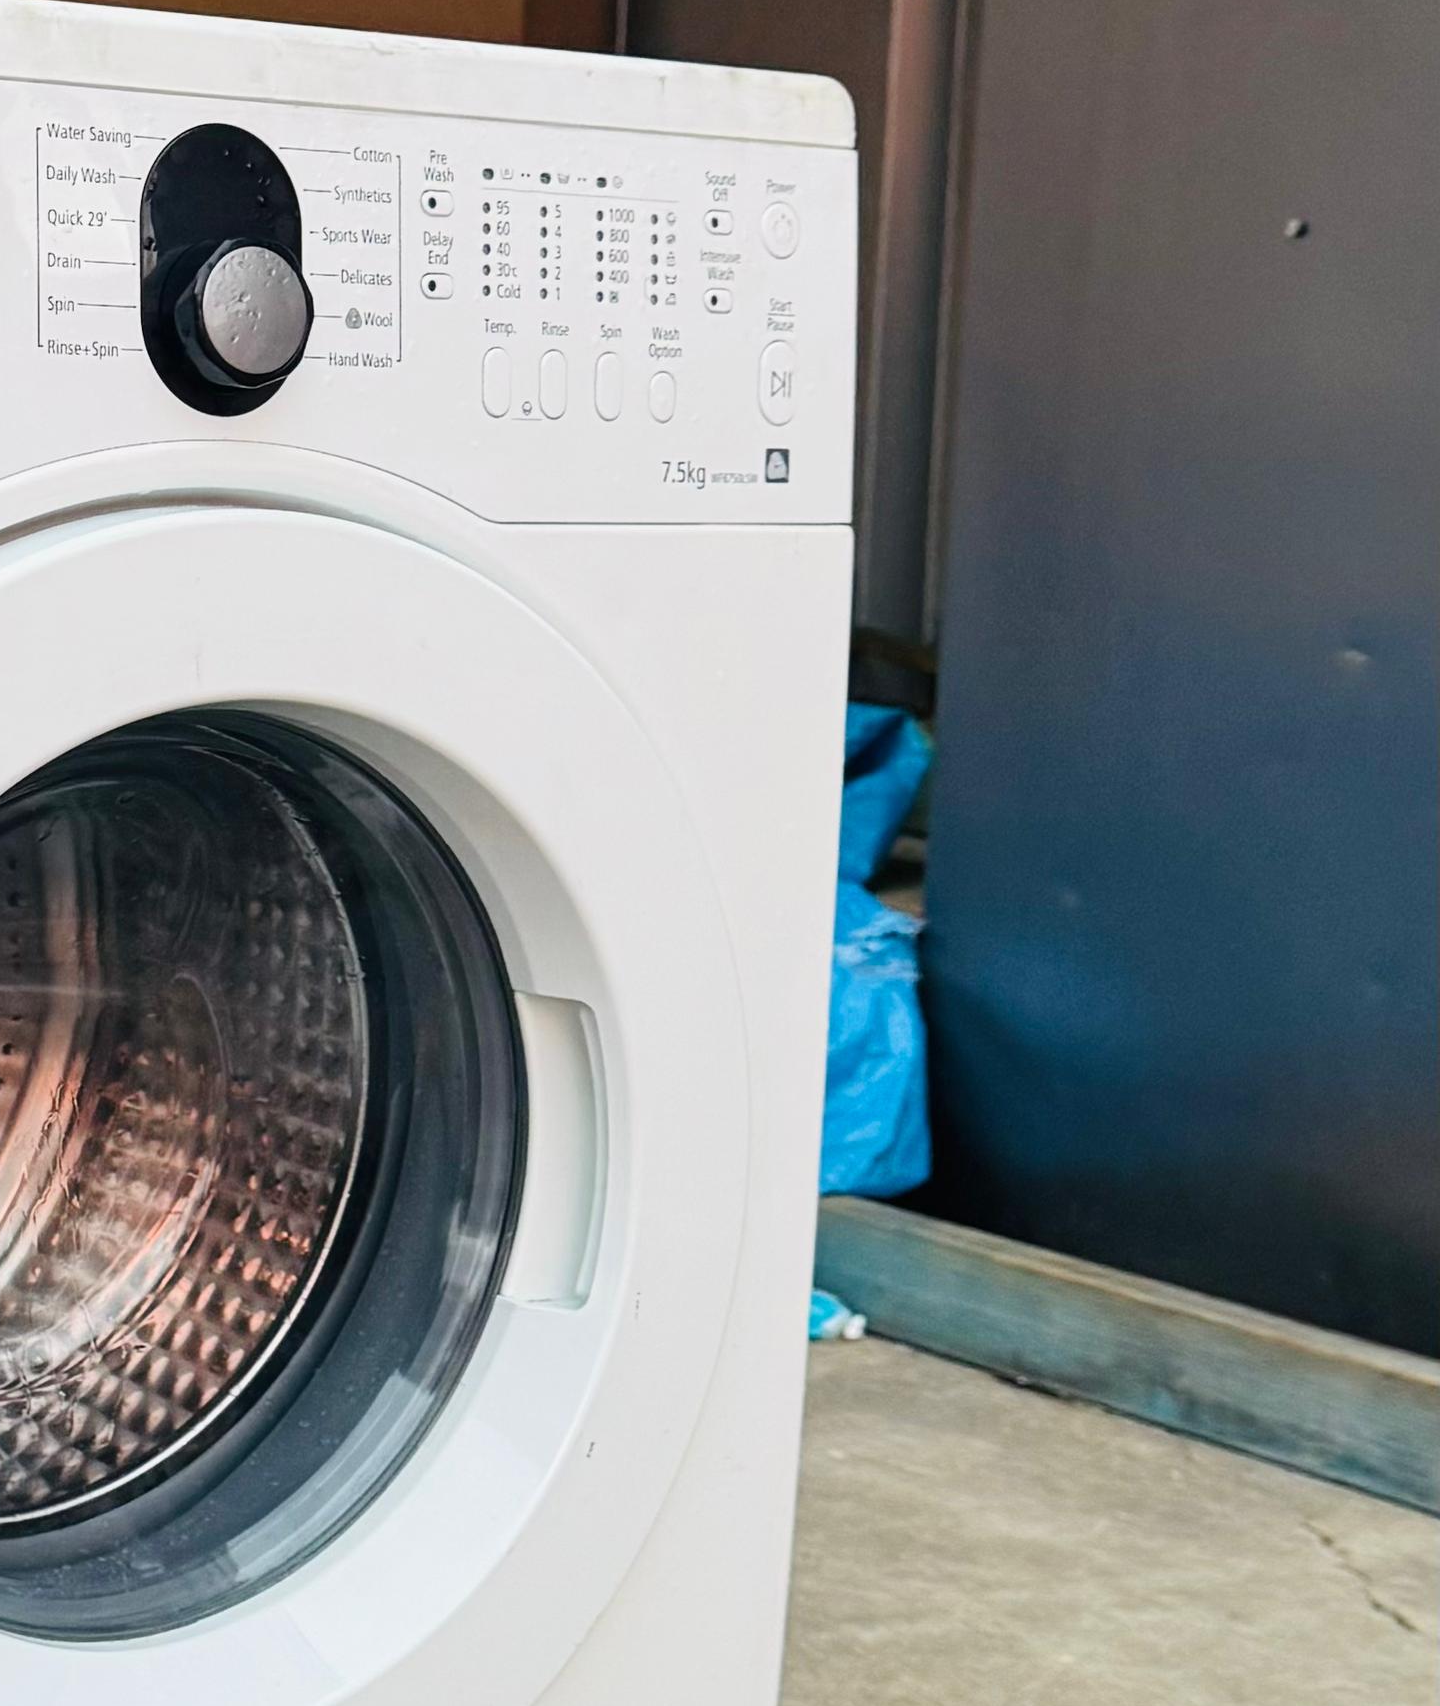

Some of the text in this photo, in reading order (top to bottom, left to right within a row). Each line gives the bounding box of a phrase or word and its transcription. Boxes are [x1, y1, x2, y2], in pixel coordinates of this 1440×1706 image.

[46, 122, 132, 148] Water Saving
[353, 146, 393, 163] Cotton
[429, 149, 448, 165] Pre
[46, 164, 116, 186] Daily Wash
[423, 166, 454, 182] Wash
[334, 185, 393, 205] Synthetics
[496, 200, 510, 215] 95
[555, 204, 562, 219] 5
[609, 208, 635, 223] 1000
[47, 208, 83, 227] Quick
[322, 226, 392, 245] Sports Wear
[496, 220, 511, 236] 60
[554, 225, 562, 238] 4
[609, 228, 630, 244] 800
[423, 230, 454, 253] Delay
[496, 242, 511, 257] 40
[47, 252, 81, 269] Drain
[428, 250, 449, 265] End
[554, 245, 562, 260] 3
[608, 248, 630, 264] 600
[340, 268, 393, 286] Delicates
[554, 266, 561, 281] 2
[609, 269, 630, 284] 400
[496, 283, 521, 299] Cold
[47, 295, 75, 315] Spin
[363, 311, 393, 327] Wool
[484, 318, 517, 338] Temp.
[541, 321, 570, 337] Rinse
[600, 324, 622, 340] Spin
[652, 326, 680, 341] Wash
[47, 338, 119, 360] Rinse+Spin
[648, 343, 683, 360] Option
[329, 352, 393, 368] Hand Wash
[661, 460, 706, 490] 7.5kg
